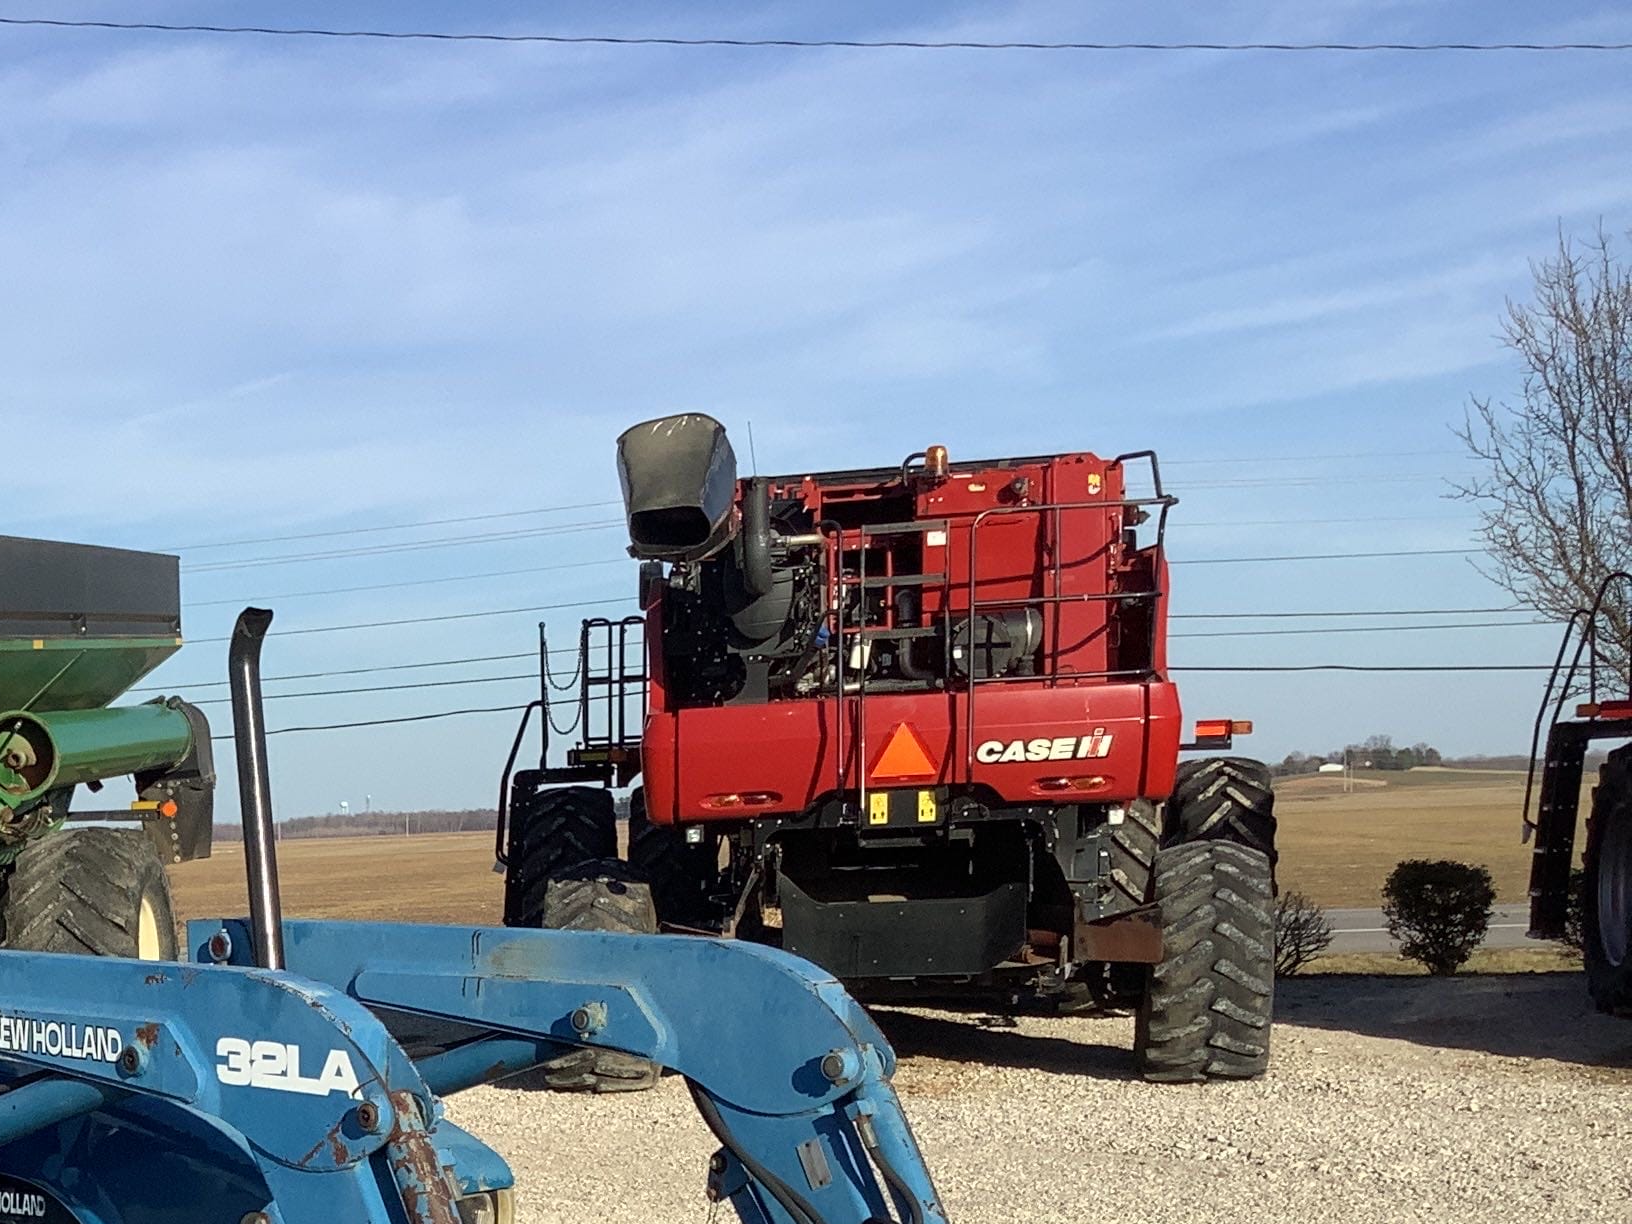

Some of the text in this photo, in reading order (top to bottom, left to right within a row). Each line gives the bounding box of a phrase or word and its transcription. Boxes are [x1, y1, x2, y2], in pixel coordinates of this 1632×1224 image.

[976, 737, 1077, 764] CASE
[32, 1019, 123, 1063] HOLLAND
[216, 1036, 365, 1101] 32LA
